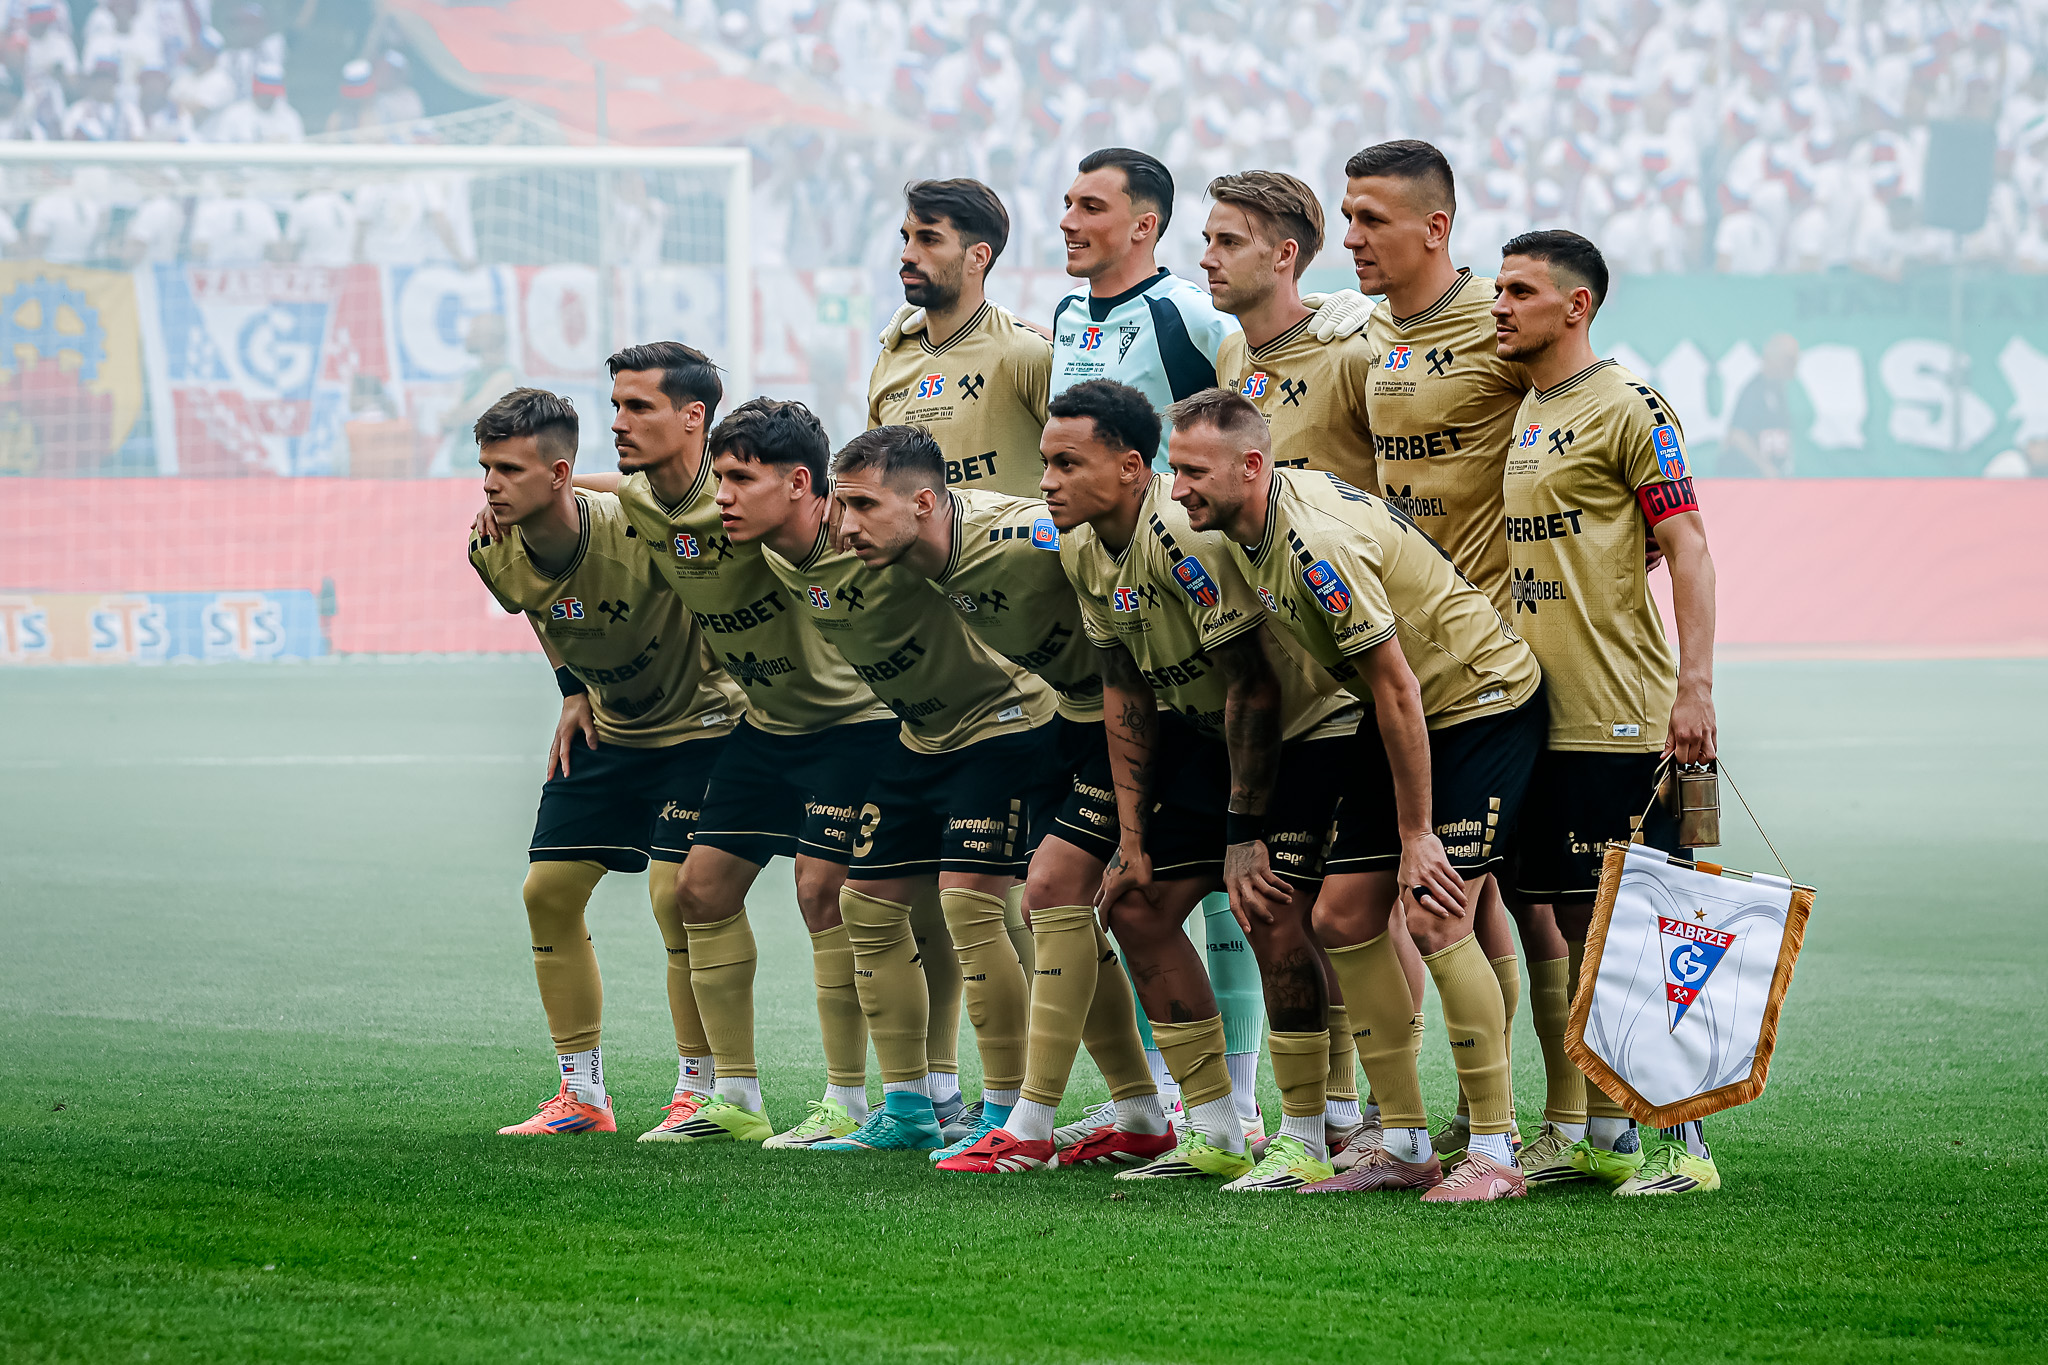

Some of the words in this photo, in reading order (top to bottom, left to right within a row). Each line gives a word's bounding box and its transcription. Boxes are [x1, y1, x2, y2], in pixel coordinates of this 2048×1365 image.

[1079, 327, 1103, 351] STS
[1385, 346, 1411, 371] STS
[917, 373, 945, 399] STS
[1242, 373, 1268, 398] STS
[1519, 424, 1542, 449] STS
[674, 533, 700, 558] STS
[551, 596, 585, 620] STS
[807, 585, 831, 610] STS
[1113, 586, 1140, 613] STS
[93, 603, 161, 652] STS
[210, 600, 278, 650] STS
[950, 816, 1005, 830] corendon
[1434, 818, 1482, 836] rendon
[1444, 841, 1481, 857] apelli
[1661, 919, 1729, 948] ZABRZE
[1669, 944, 1708, 983] G
